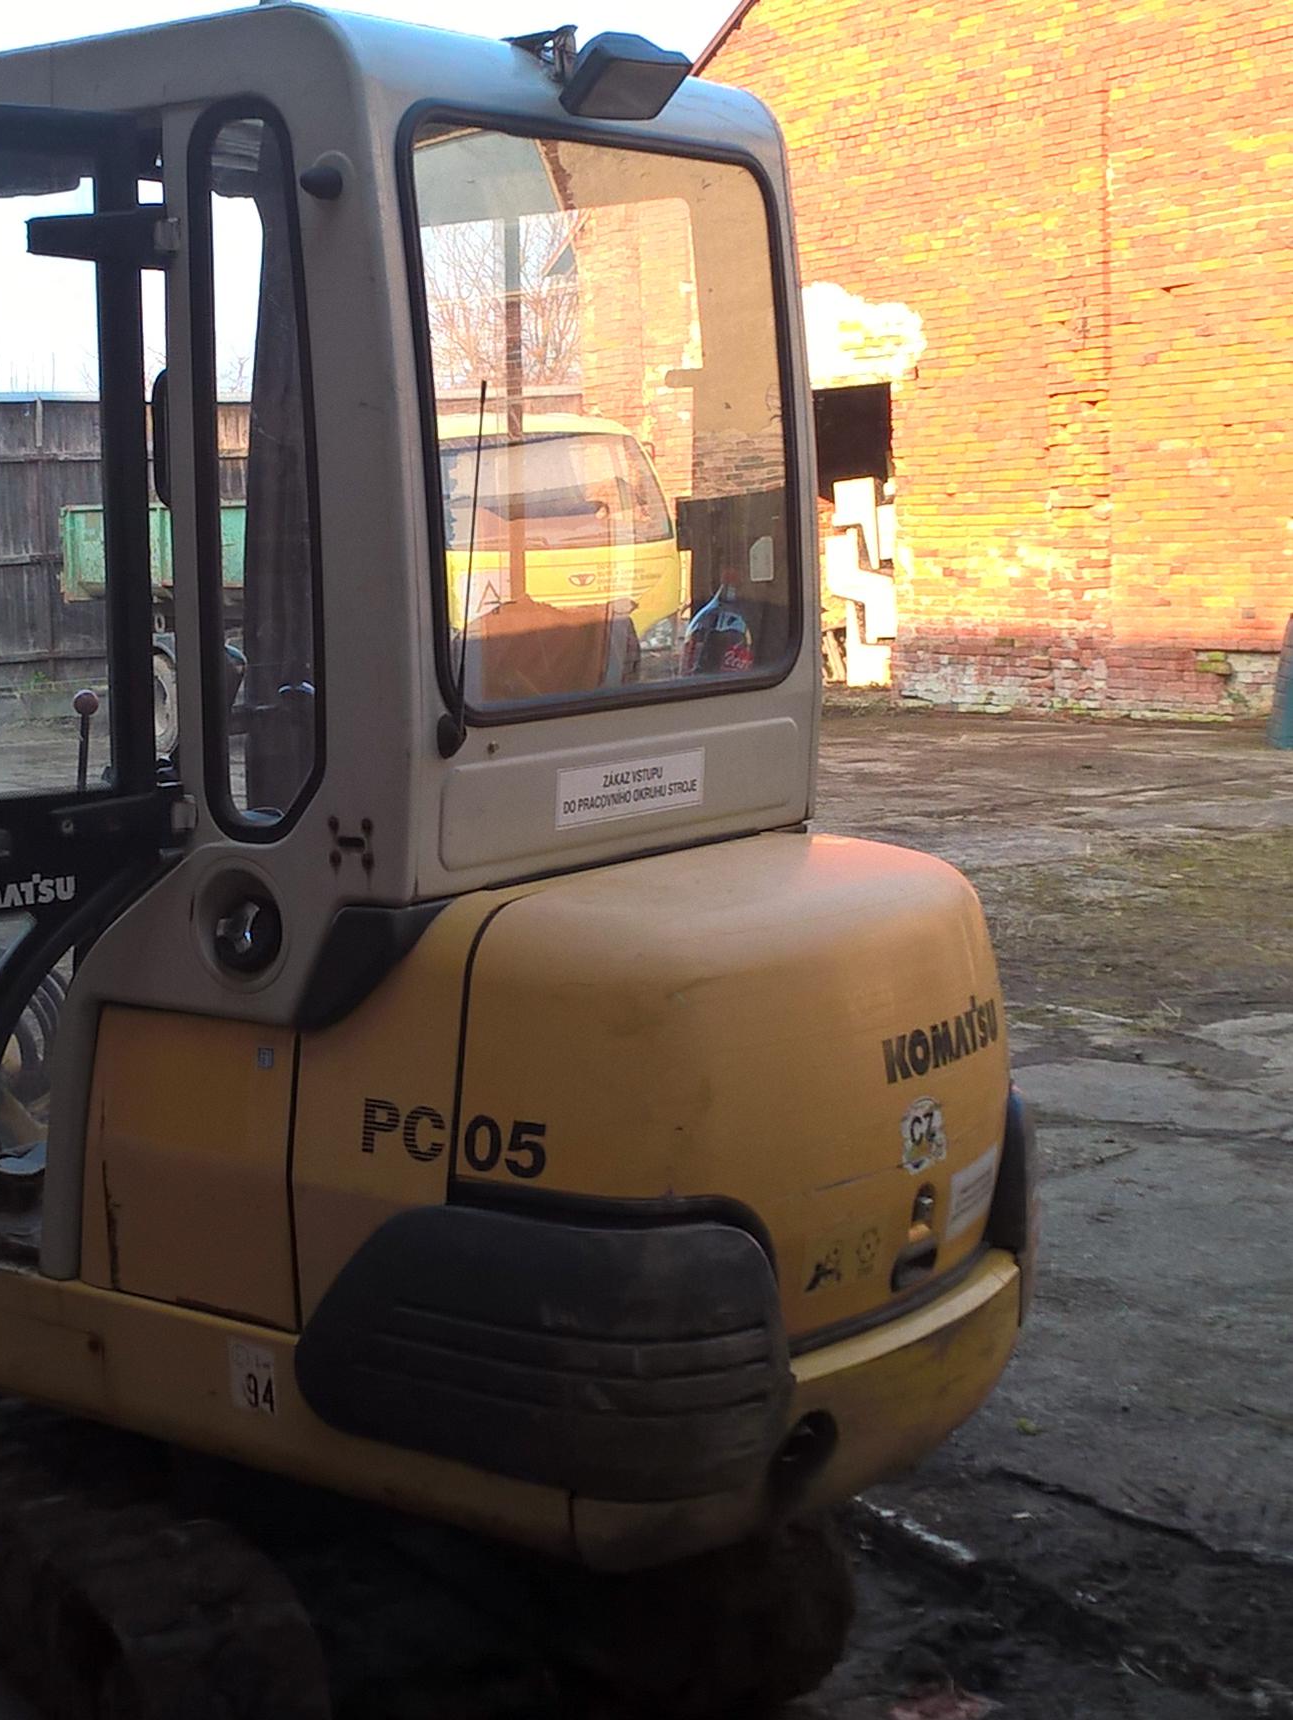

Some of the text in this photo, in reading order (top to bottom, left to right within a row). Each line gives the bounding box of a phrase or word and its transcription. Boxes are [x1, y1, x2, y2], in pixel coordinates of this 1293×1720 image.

[563, 778, 697, 814] DO PRACOVNÍHO OKRUHU STROJE
[602, 767, 663, 788] ZÁKAZ VSTUPU
[882, 995, 998, 1084] KOMATSU
[361, 1098, 547, 1179] PC 05
[910, 1111, 937, 1146] CZ
[245, 1373, 275, 1413] 94
